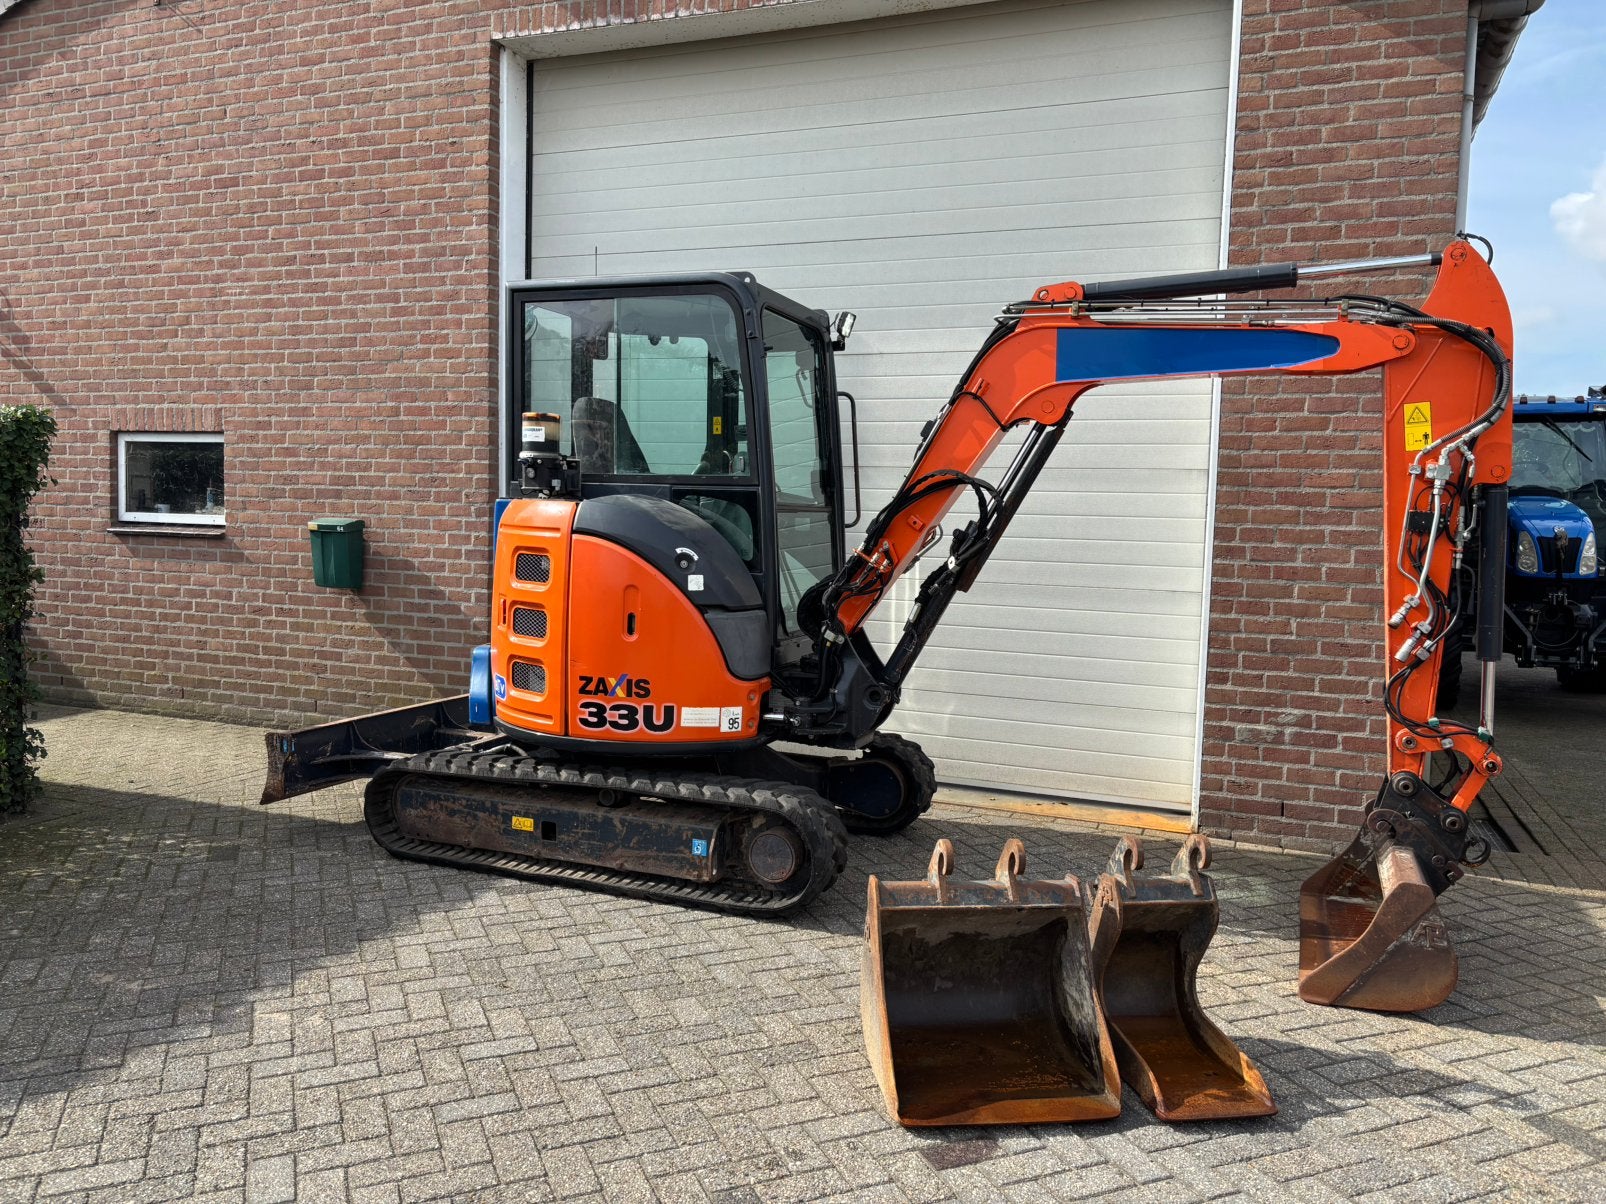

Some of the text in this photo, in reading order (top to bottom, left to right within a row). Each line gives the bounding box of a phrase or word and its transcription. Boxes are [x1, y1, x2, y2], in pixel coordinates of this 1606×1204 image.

[578, 673, 651, 699] ZAXIS
[578, 701, 675, 733] 33U
[727, 717, 740, 730] 95
